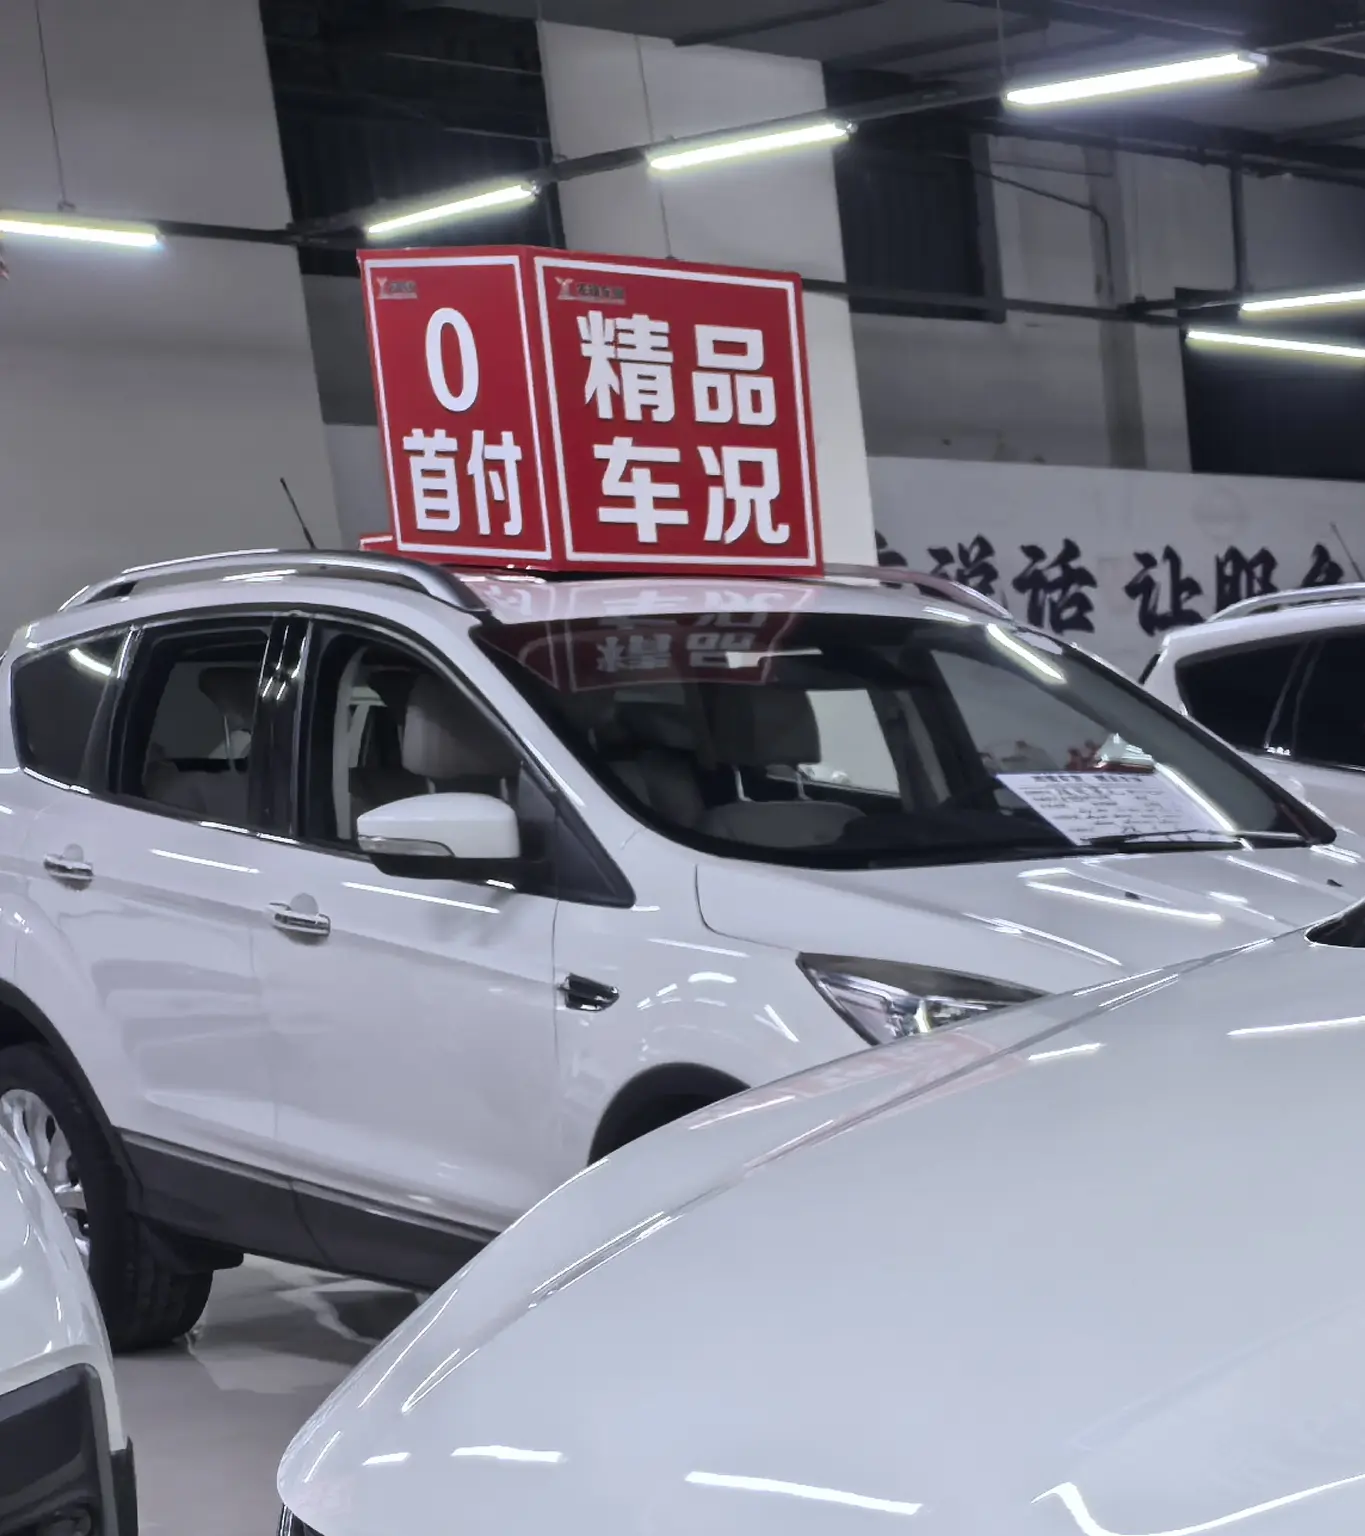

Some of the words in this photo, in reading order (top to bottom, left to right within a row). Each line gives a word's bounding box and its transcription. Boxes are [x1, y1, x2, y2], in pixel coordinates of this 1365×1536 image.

[425, 307, 480, 413] 0
[577, 309, 777, 426] 精品
[403, 427, 523, 536] 首付
[593, 436, 790, 545] 车况
[874, 529, 1098, 635] 说话
